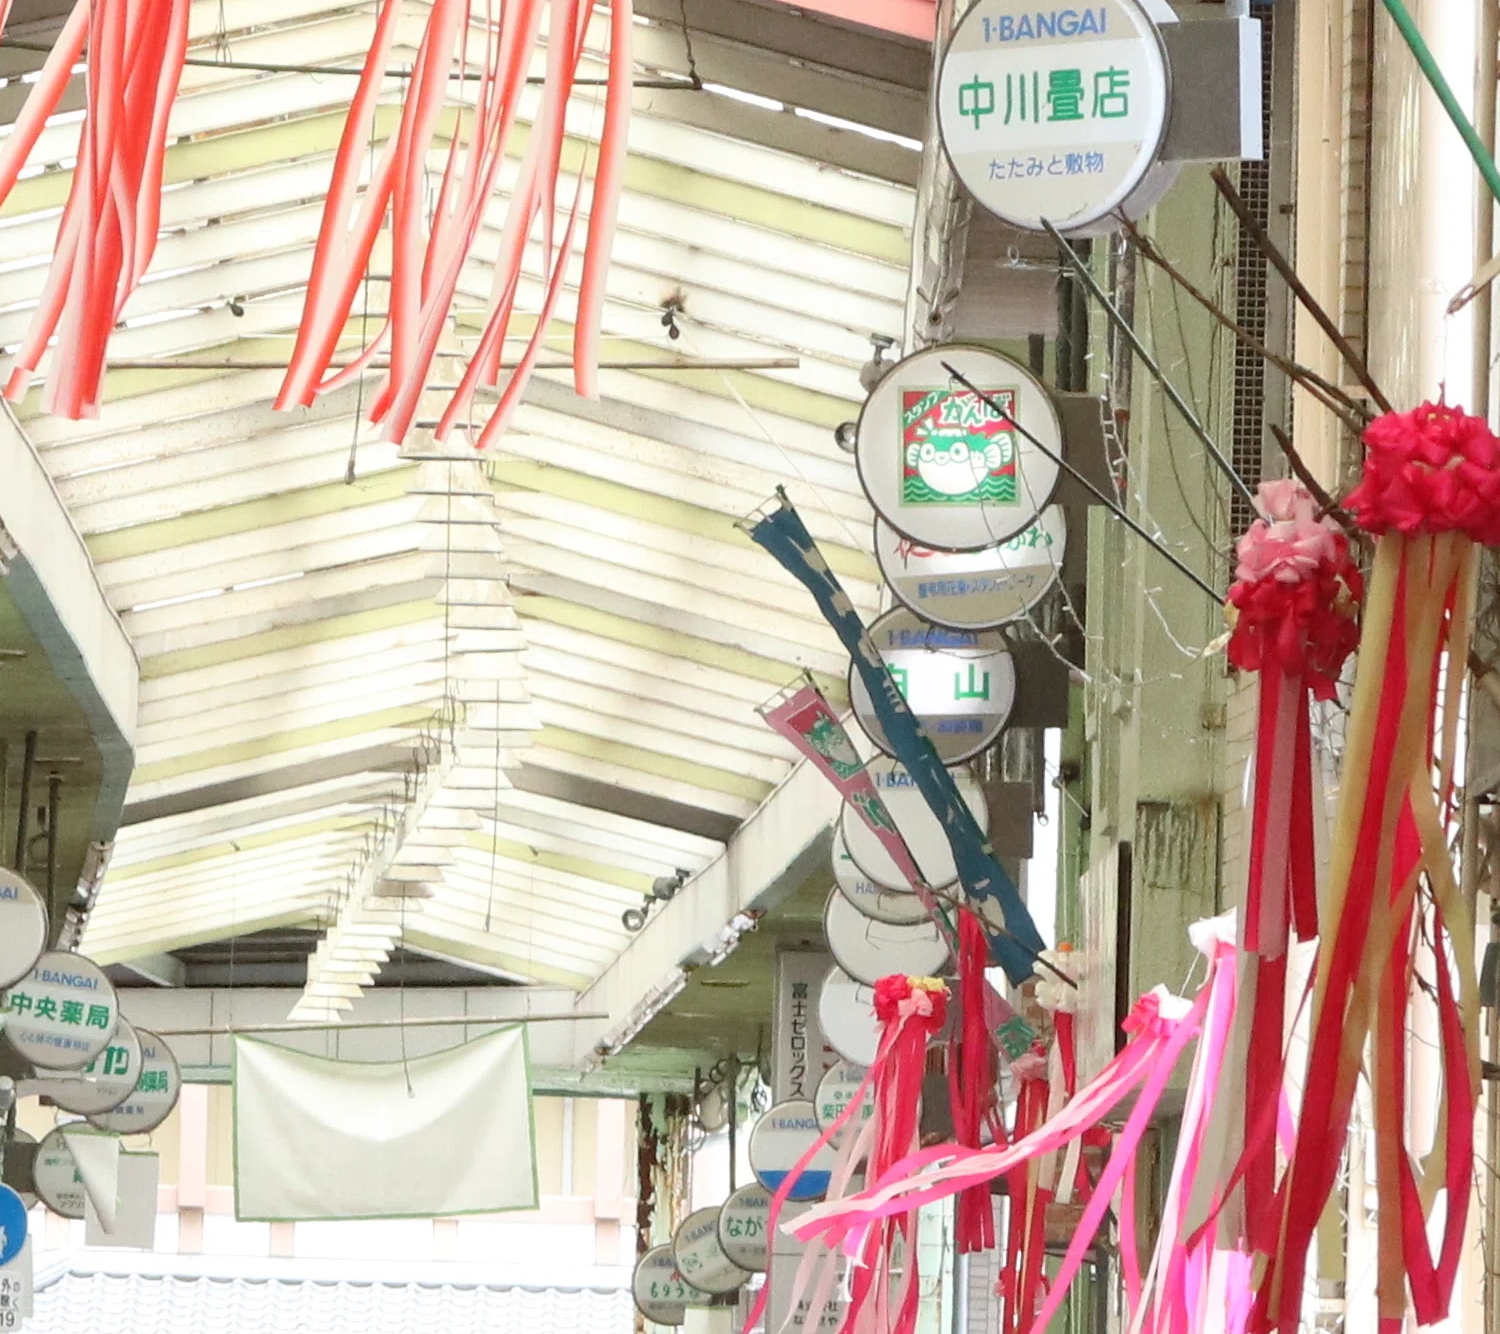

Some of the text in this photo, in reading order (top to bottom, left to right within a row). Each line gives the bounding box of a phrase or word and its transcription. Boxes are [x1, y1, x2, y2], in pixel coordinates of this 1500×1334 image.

[958, 65, 1131, 131] 中川畳店
[988, 150, 1105, 181] たたみと敷物
[10, 990, 110, 1030] 中央薬局
[789, 982, 809, 1098] 富士ゼロックス
